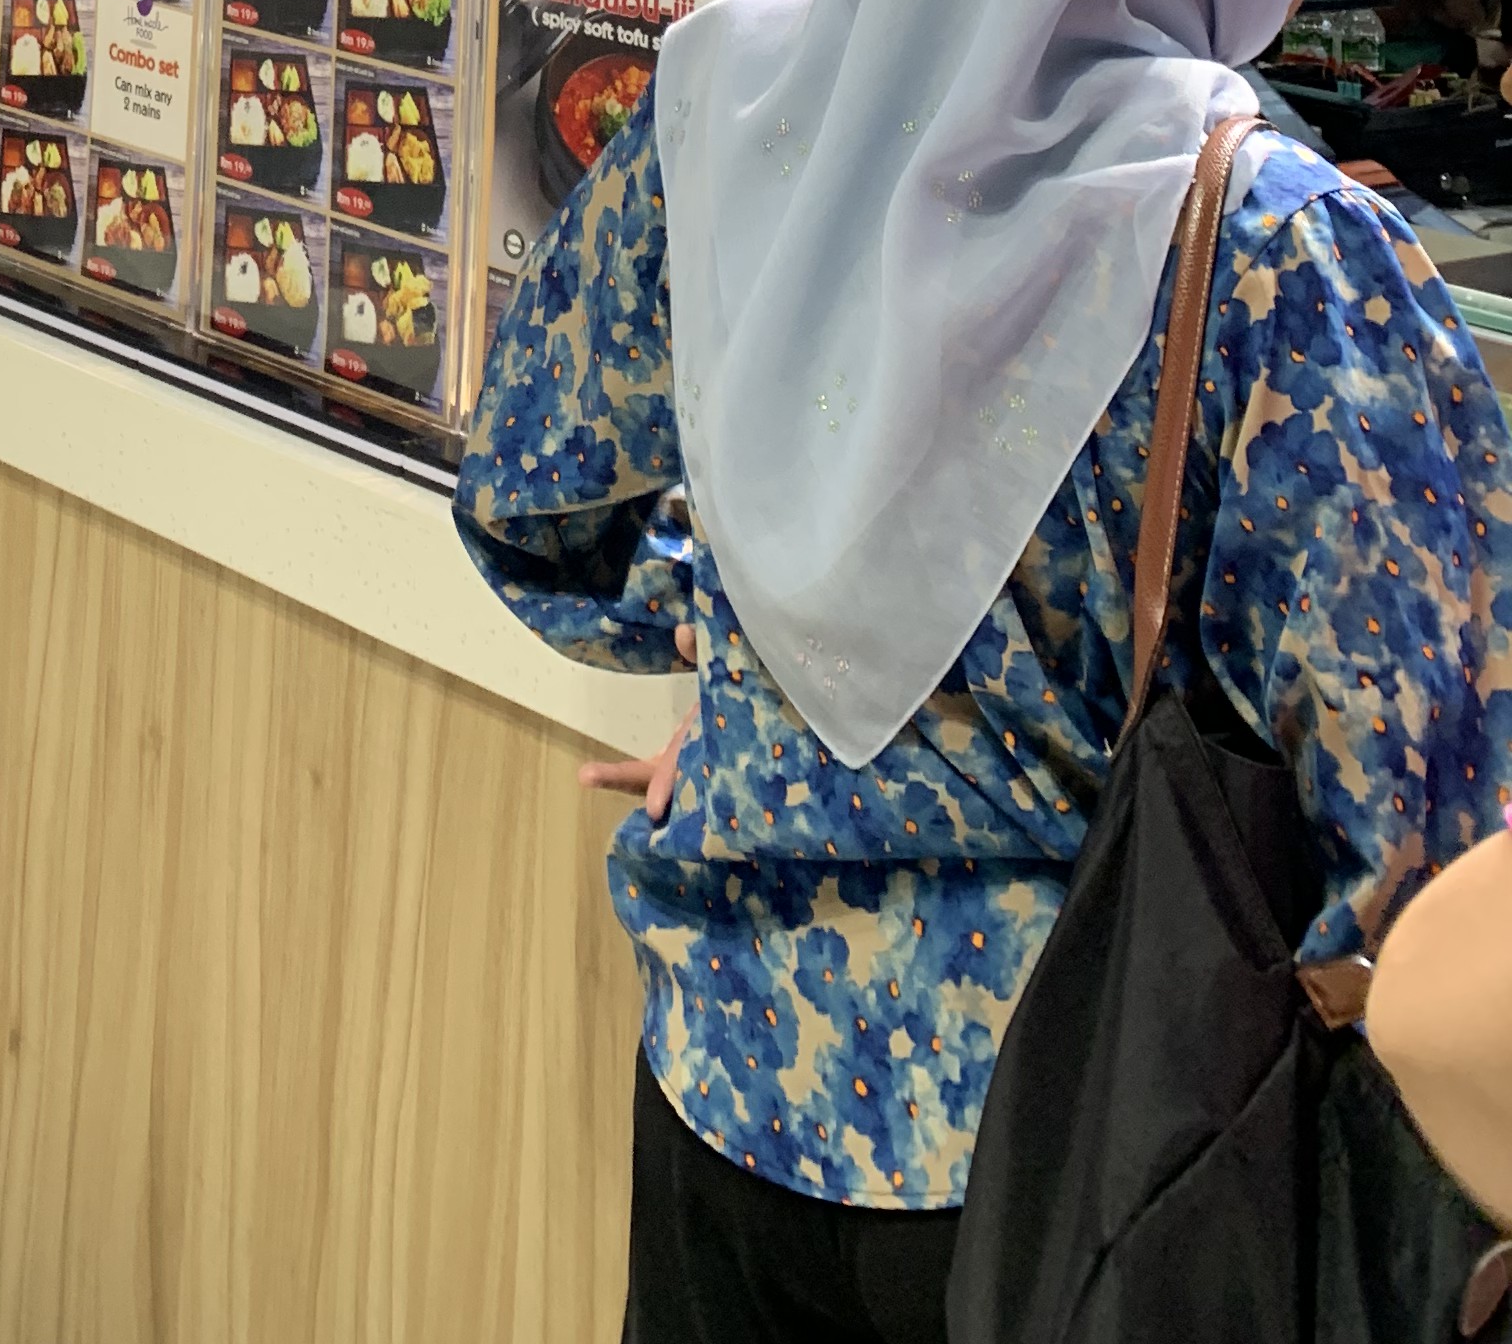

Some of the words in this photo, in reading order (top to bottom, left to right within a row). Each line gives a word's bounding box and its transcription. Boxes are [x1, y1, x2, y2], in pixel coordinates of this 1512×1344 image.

[541, 10, 582, 35] spicy
[583, 21, 615, 41] soft
[617, 24, 649, 50] tofu
[109, 43, 155, 72] Combo
[158, 59, 180, 79] set
[114, 76, 132, 94] Can
[135, 81, 153, 99] mix
[154, 89, 173, 106] any
[123, 97, 130, 111] 2
[132, 100, 162, 121] mains
